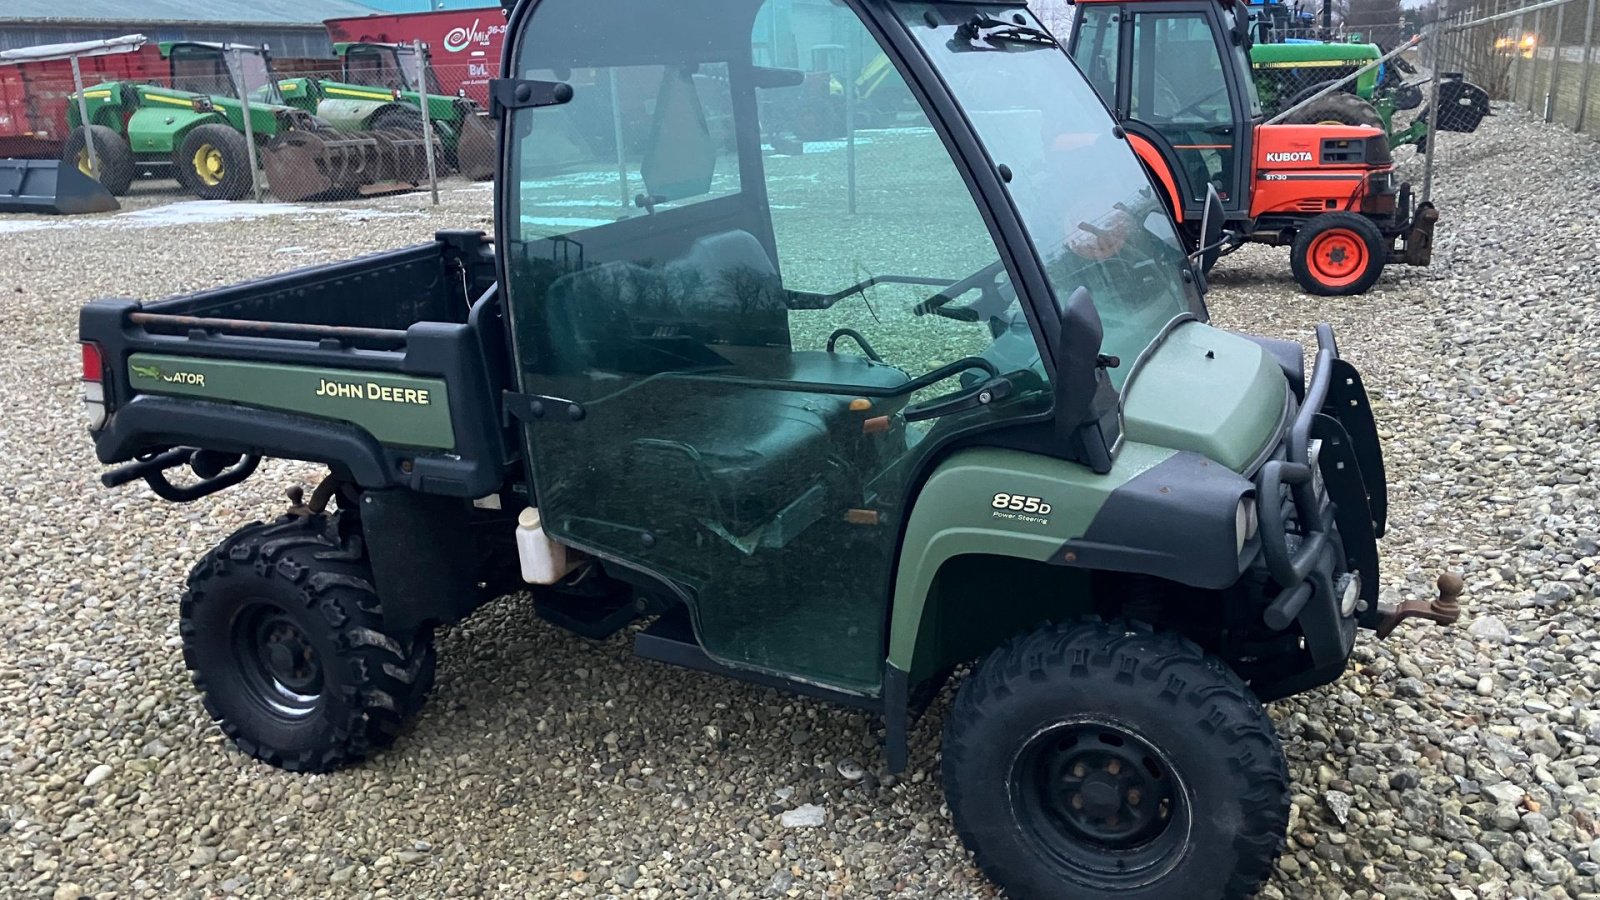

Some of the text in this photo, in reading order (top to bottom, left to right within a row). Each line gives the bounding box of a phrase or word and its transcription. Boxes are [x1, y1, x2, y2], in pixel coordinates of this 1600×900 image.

[1266, 152, 1313, 162] KUBOTA
[316, 379, 430, 405] JOHN DEERE
[991, 492, 1052, 515] 855D
[993, 511, 1048, 525] Power Steering
